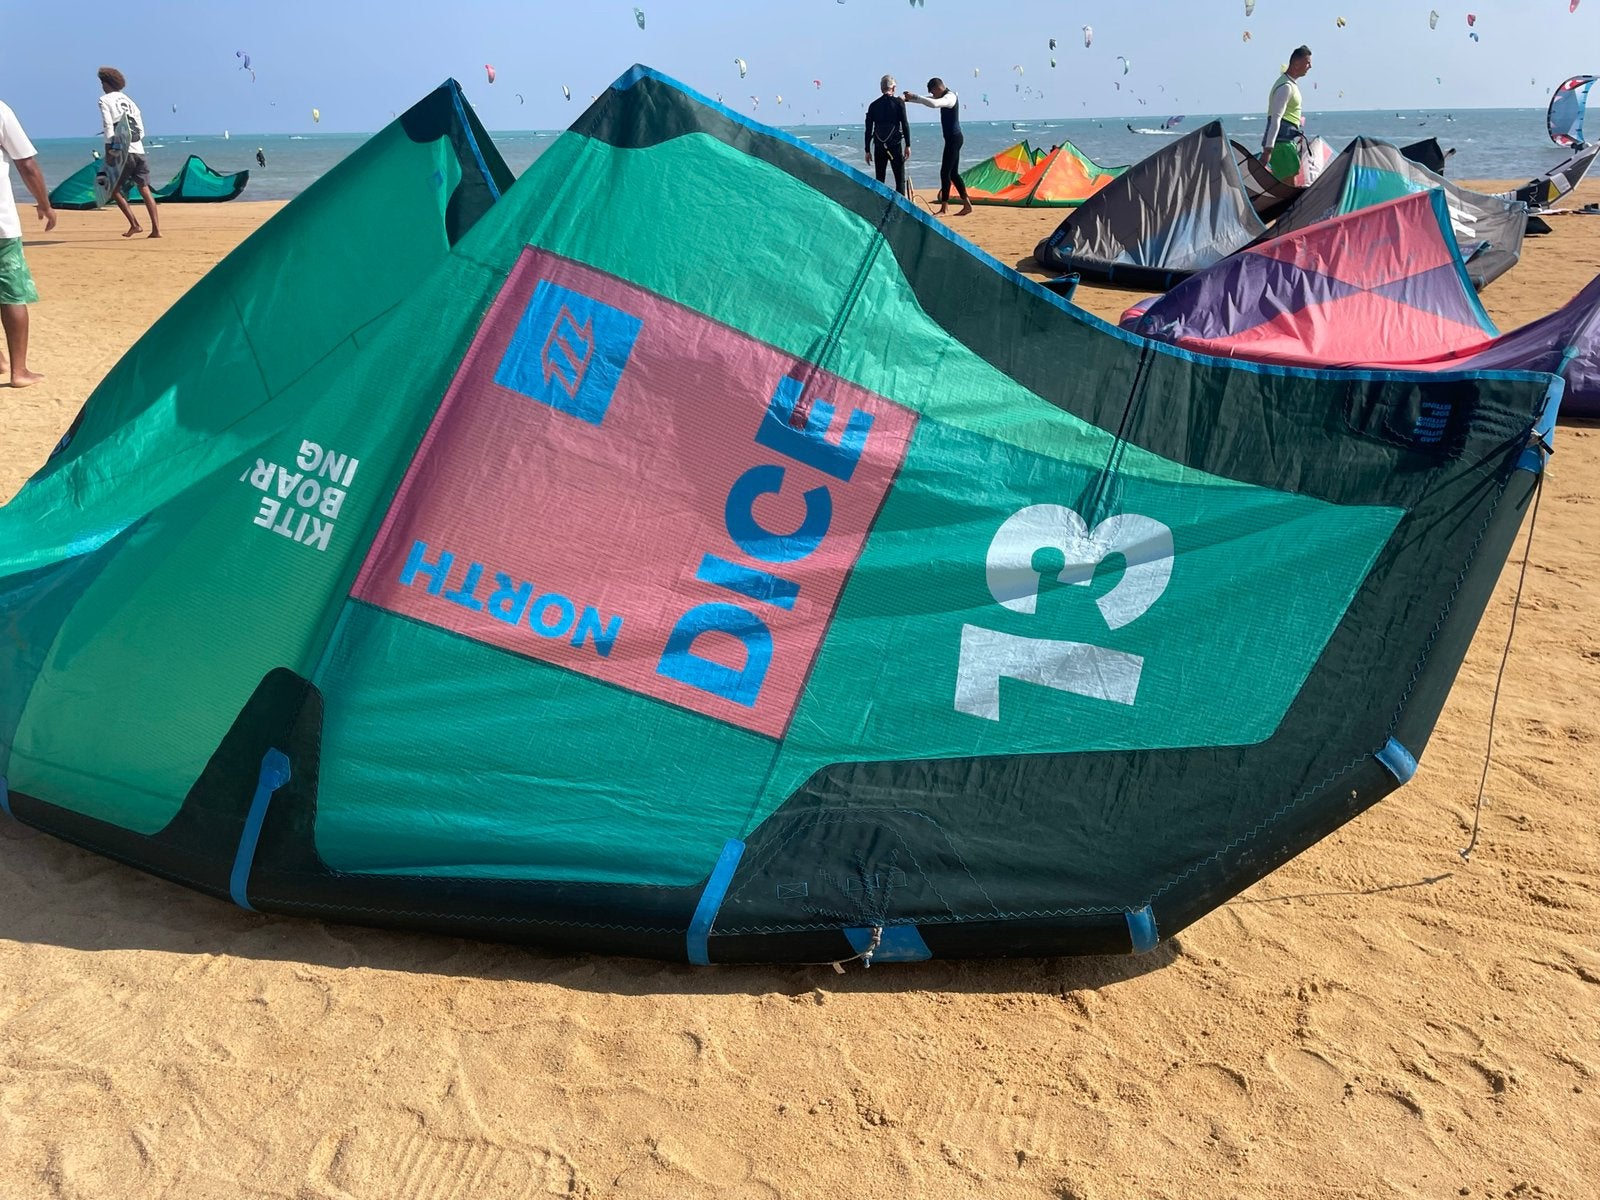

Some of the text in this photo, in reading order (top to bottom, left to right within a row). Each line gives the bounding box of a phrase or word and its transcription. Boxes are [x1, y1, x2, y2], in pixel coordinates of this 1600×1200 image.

[239, 457, 347, 520] BOAR
[296, 439, 360, 488] ING
[253, 496, 335, 552] KITE
[655, 374, 875, 708] DICE
[398, 539, 624, 658] NORTH
[953, 503, 1175, 721] 13
